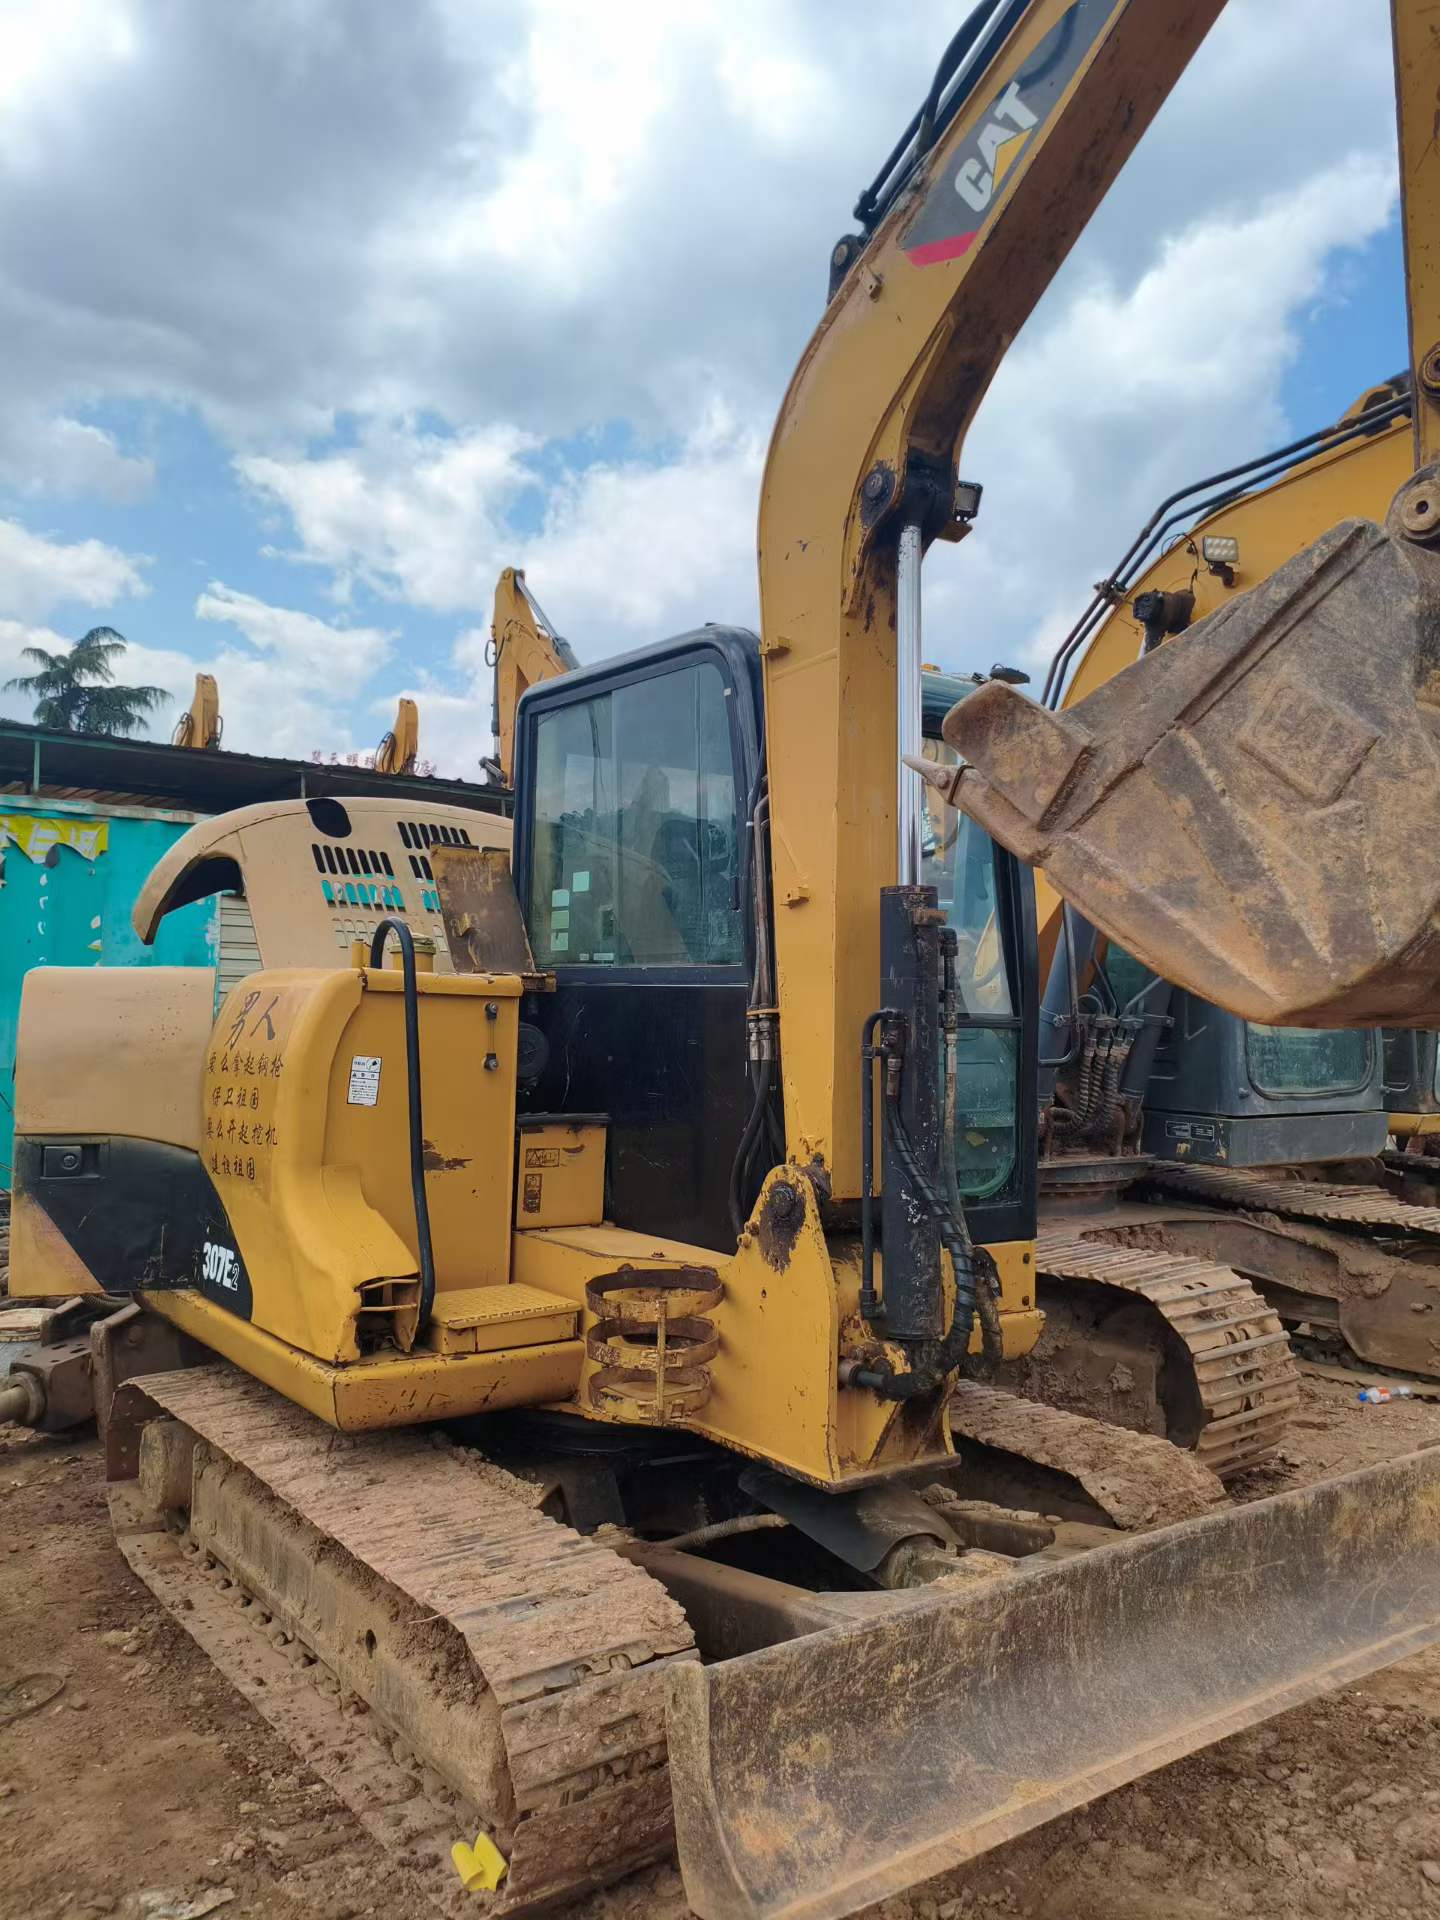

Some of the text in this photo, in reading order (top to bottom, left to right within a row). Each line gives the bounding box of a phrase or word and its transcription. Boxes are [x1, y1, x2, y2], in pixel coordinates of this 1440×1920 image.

[954, 81, 1039, 212] CAT
[225, 990, 279, 1050] 男人
[212, 1086, 259, 1111] 保卫祖国
[207, 1116, 278, 1146] 要么开起挖机
[211, 1152, 255, 1180] 建设祖国
